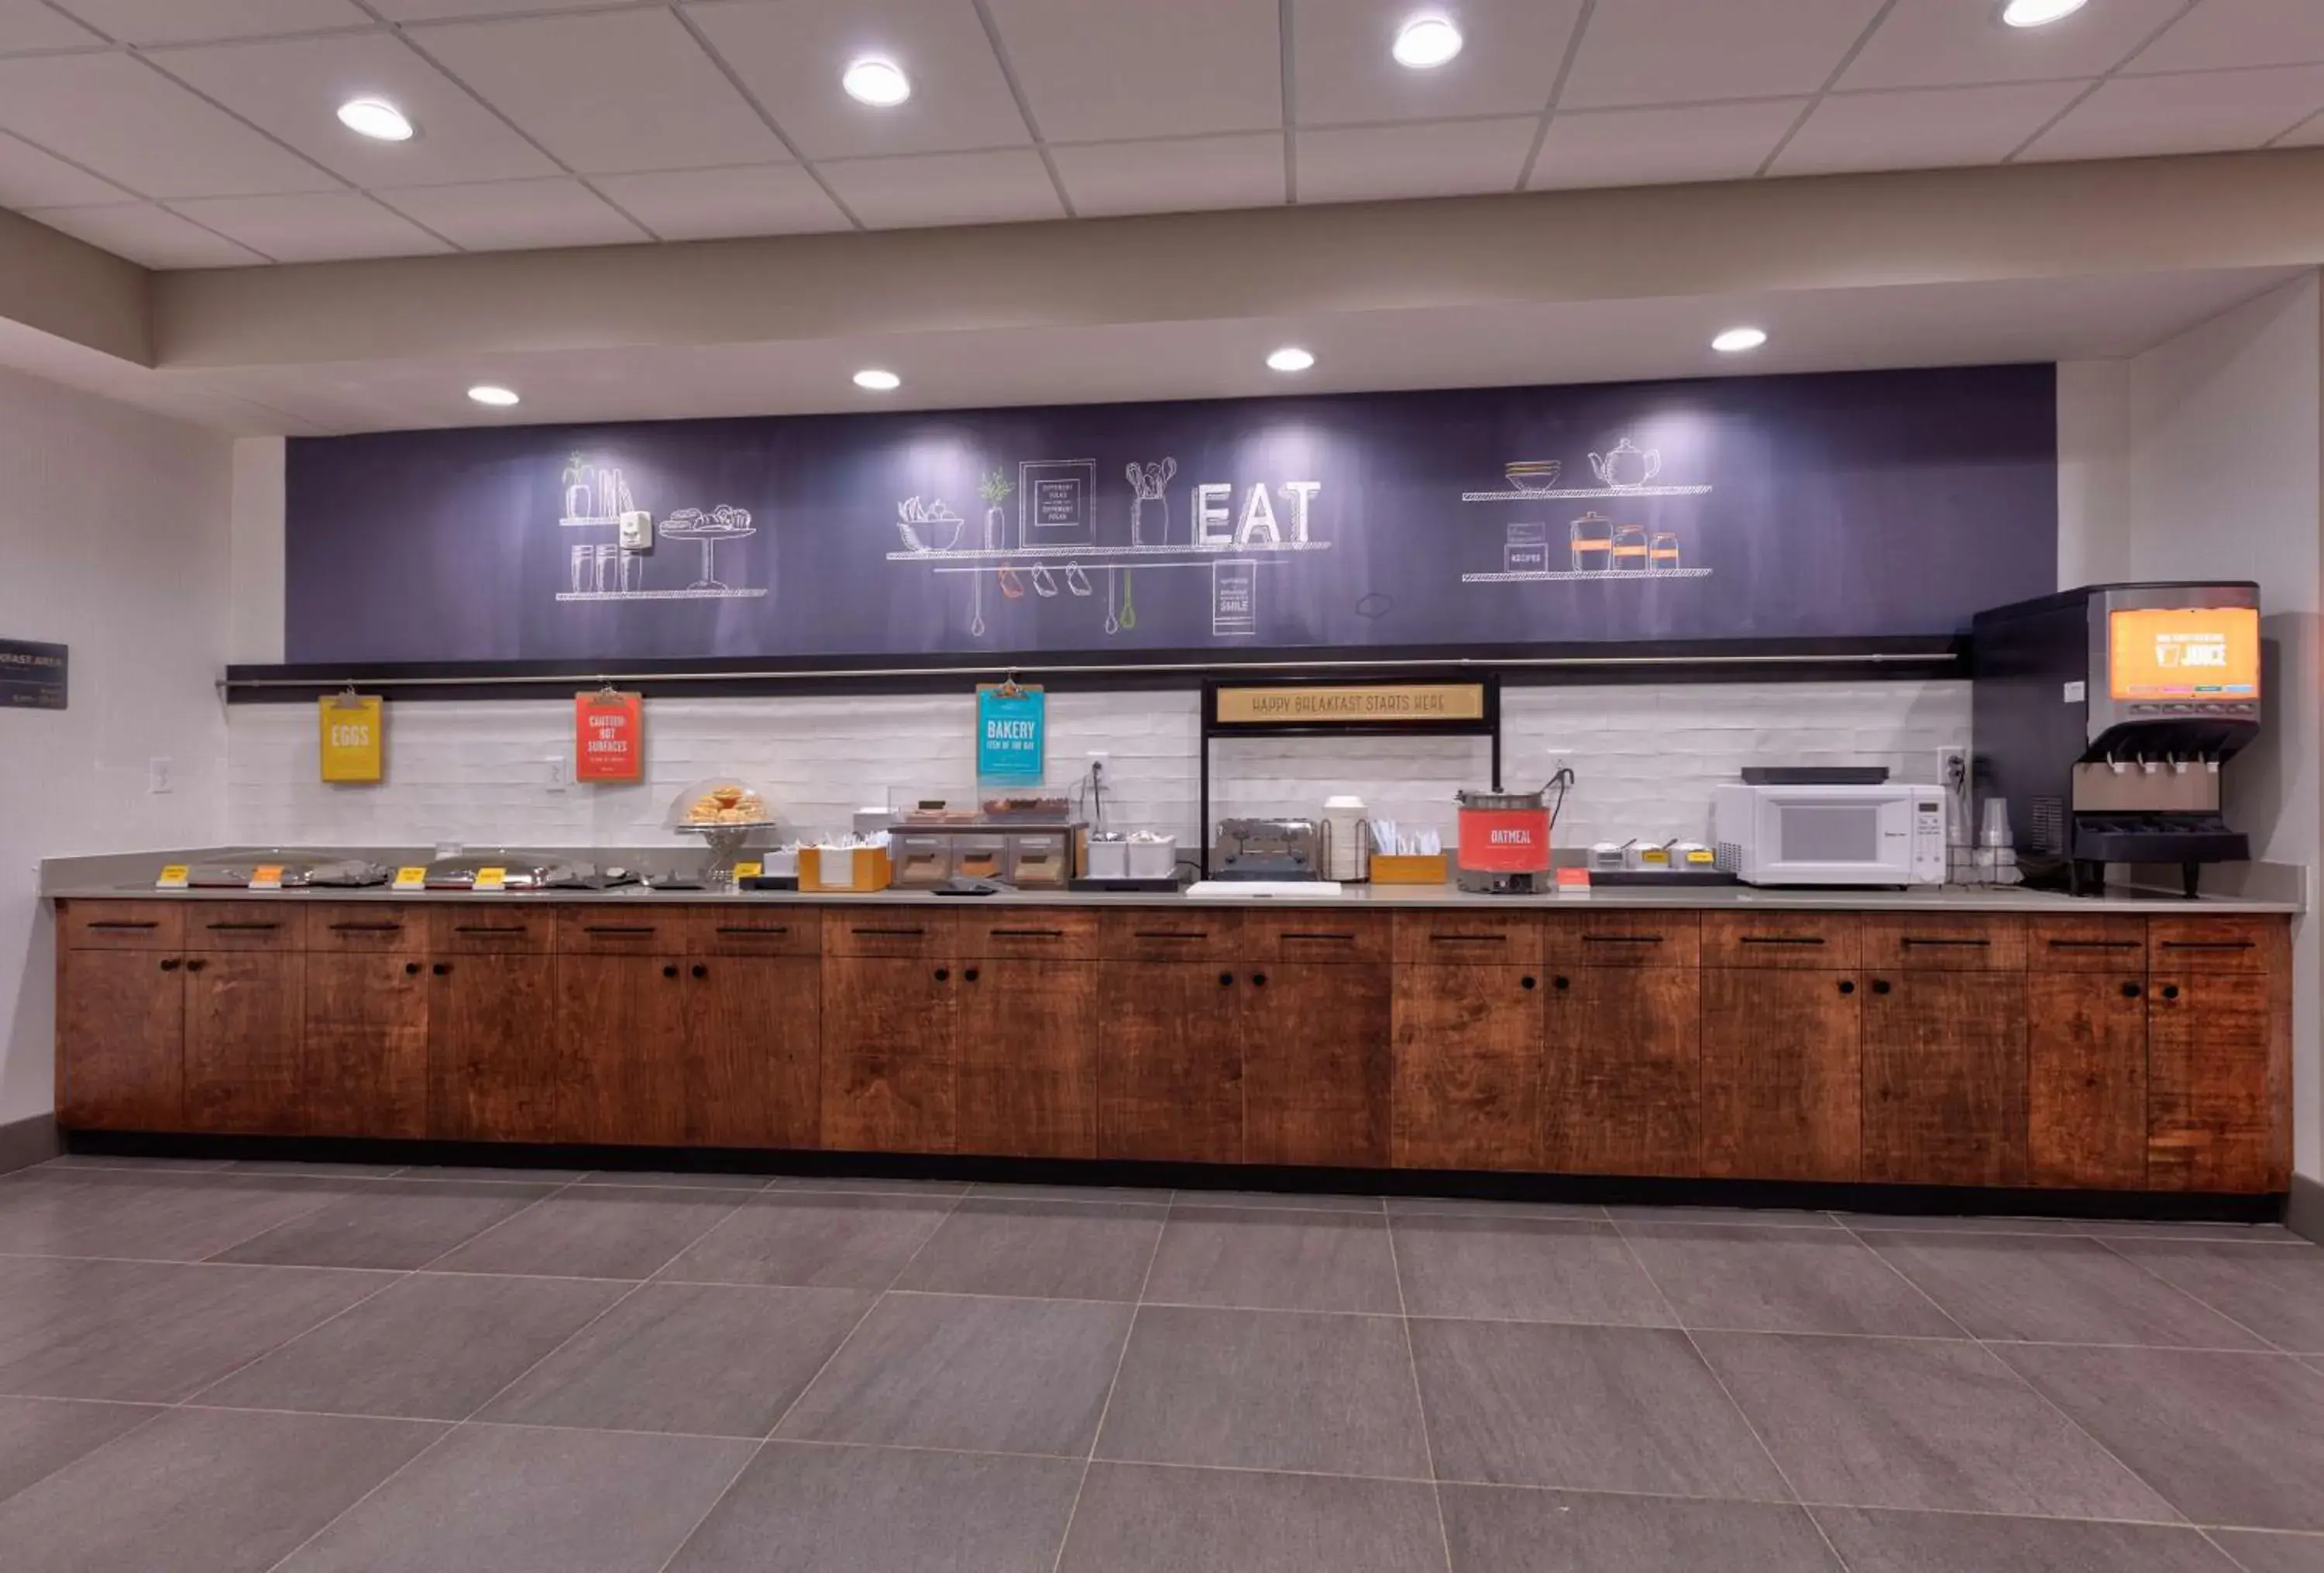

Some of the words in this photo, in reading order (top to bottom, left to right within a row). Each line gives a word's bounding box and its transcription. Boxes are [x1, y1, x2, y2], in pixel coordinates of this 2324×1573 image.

[1192, 480, 1322, 546] EAT
[1220, 601, 1249, 612] SMILE
[1252, 697, 1291, 713] HAPPY
[1294, 695, 1364, 713] BREAKFAST
[1366, 694, 1410, 712] STARTS
[1414, 694, 1445, 711] HERE
[331, 725, 370, 747] EGGS
[599, 728, 616, 740] HOT
[987, 719, 1036, 739] BAKERY
[588, 740, 627, 753] SURFACES
[1490, 829, 1532, 844] OATMEAL
